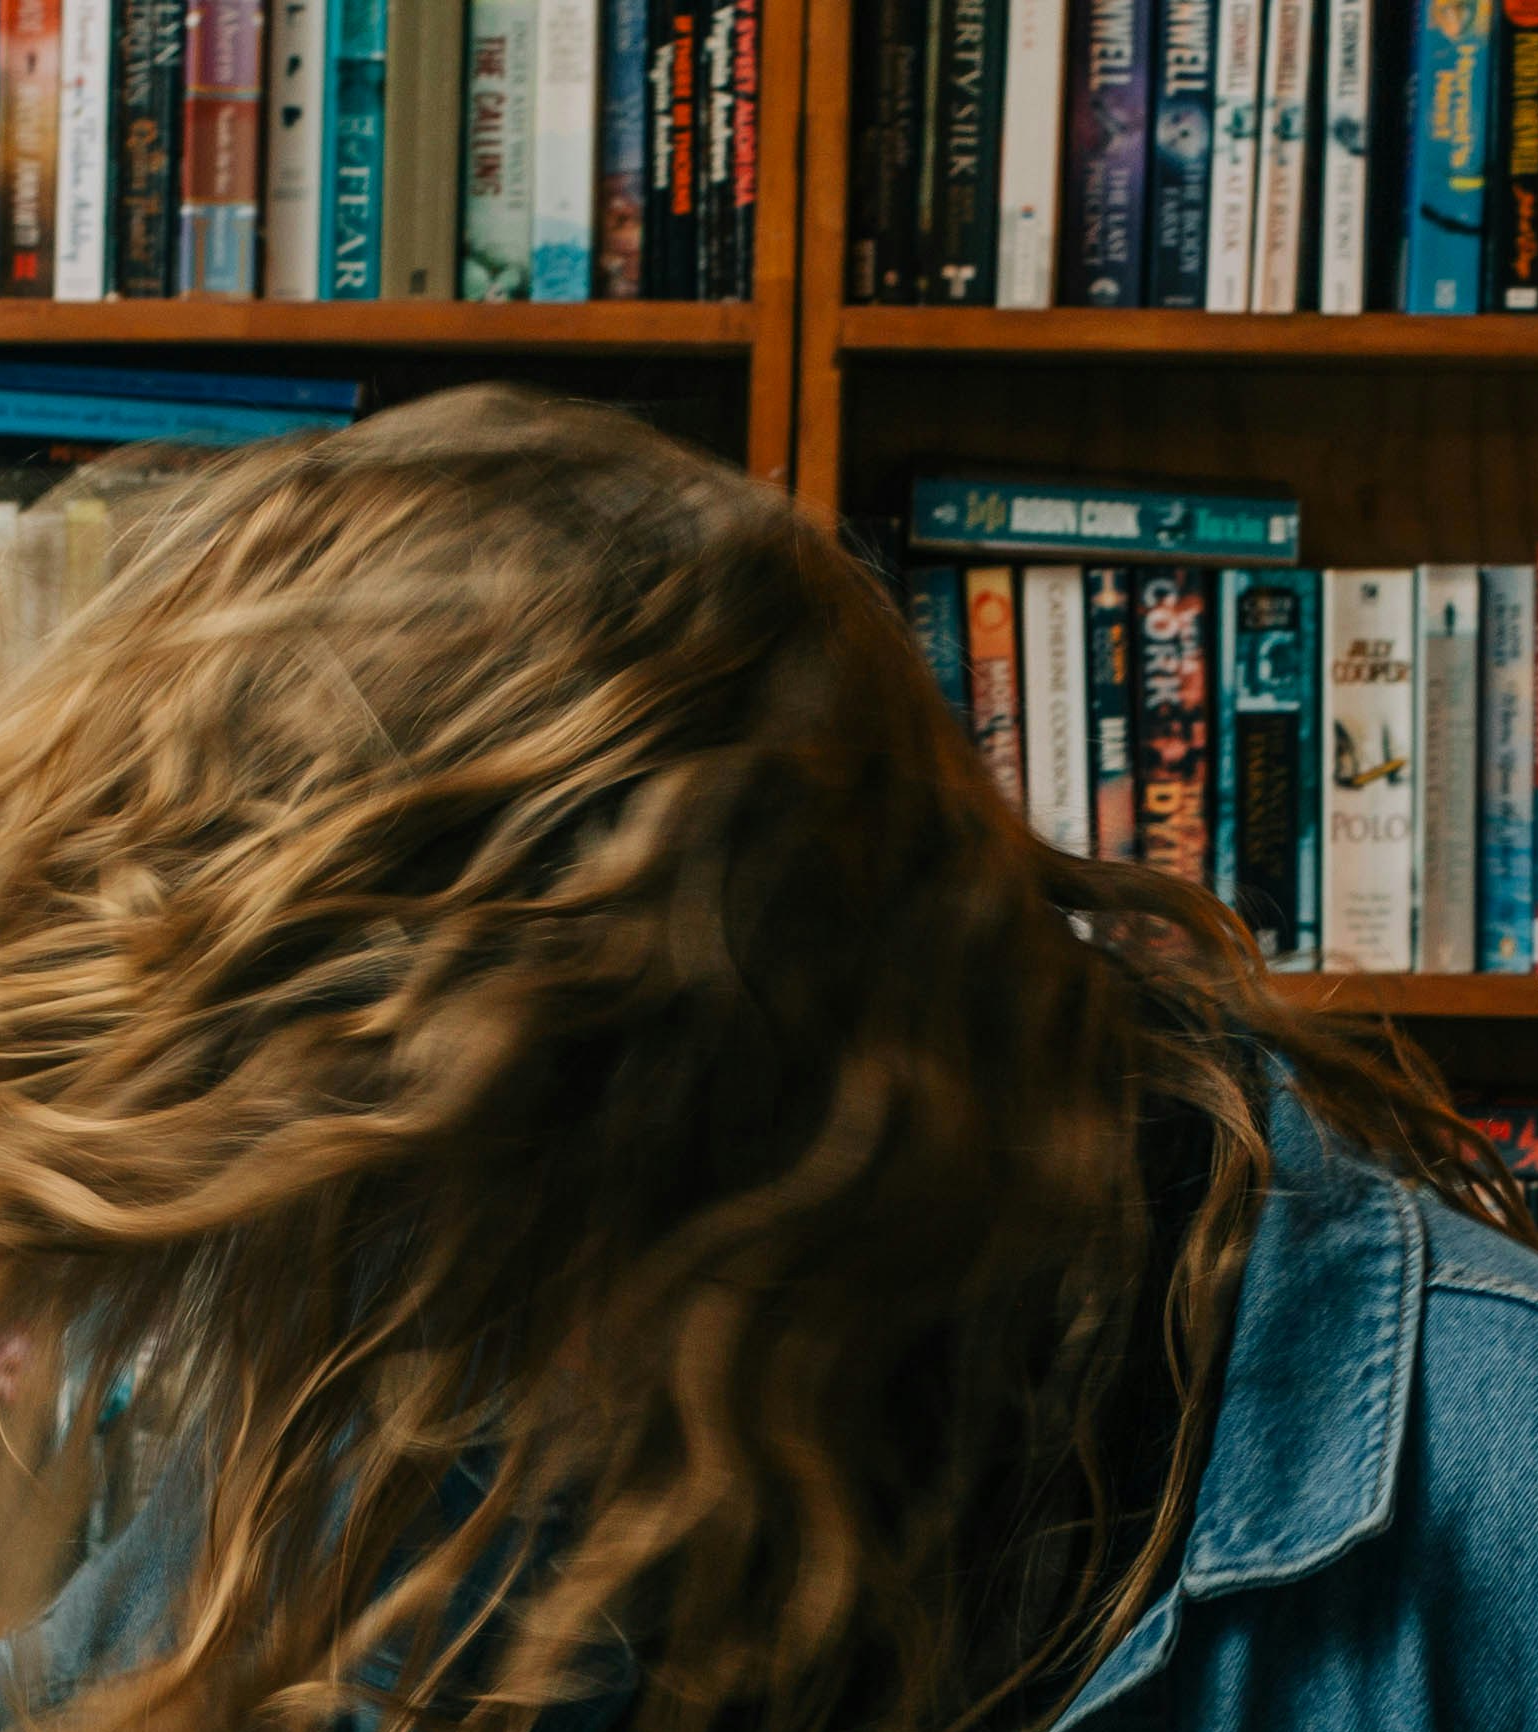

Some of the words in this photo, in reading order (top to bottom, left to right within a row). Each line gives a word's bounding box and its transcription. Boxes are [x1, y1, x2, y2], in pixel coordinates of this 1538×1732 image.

[475, 35, 504, 85] THE
[735, 19, 755, 93] SWEET
[1226, 3, 1252, 91] CORNWELL
[1335, 10, 1362, 100] CORNWELL
[947, 105, 981, 178] SILK
[1450, 44, 1474, 169] Hornet's
[471, 92, 503, 198] CALLING
[1109, 166, 1130, 206] THE
[335, 166, 368, 291] FEAR
[1106, 213, 1128, 262] LAST
[1221, 199, 1240, 252] RISK
[1142, 577, 1182, 709] CORK
[1329, 810, 1411, 843] POLO
